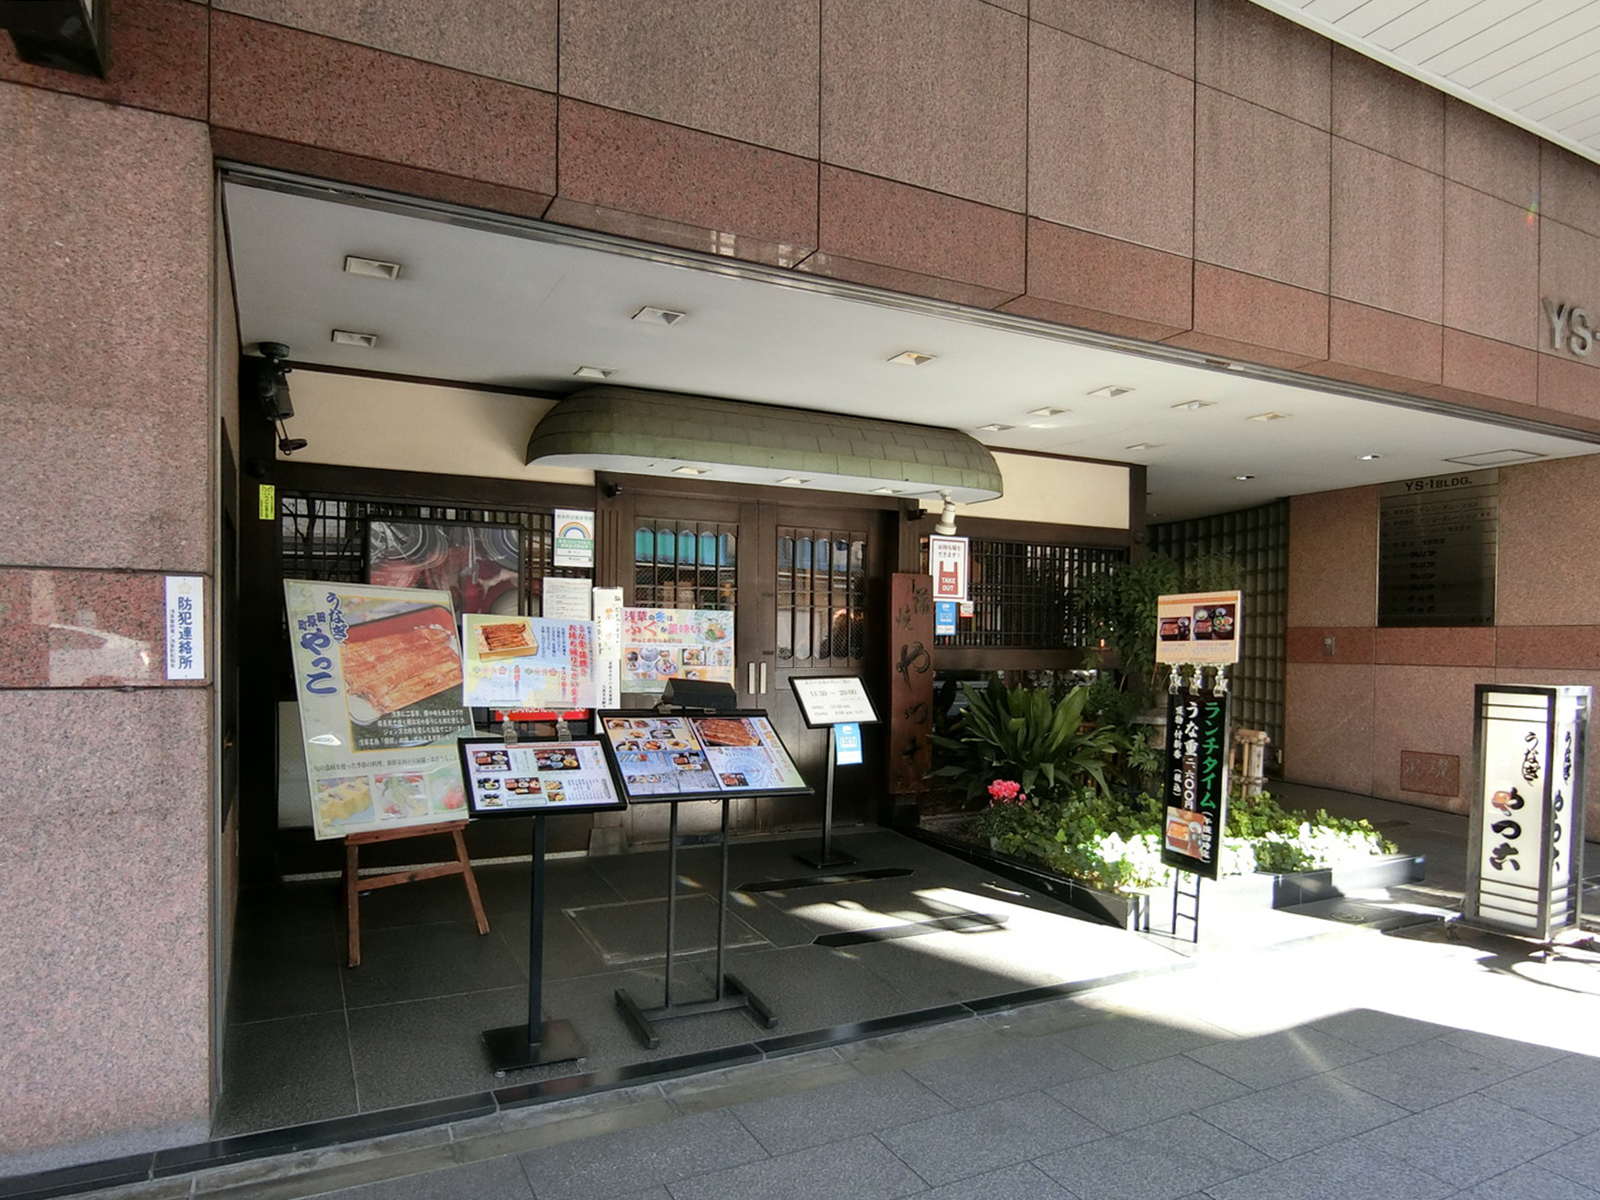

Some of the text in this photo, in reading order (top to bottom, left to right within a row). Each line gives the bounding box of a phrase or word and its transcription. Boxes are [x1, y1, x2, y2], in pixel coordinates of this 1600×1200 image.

[177, 596, 193, 670] 防犯連絡所
[326, 592, 348, 644] うなぎ
[300, 627, 338, 695] やっこ
[1184, 701, 1199, 757] うな重
[1200, 702, 1220, 809] ランチタイム
[1521, 731, 1541, 787] うなぎ
